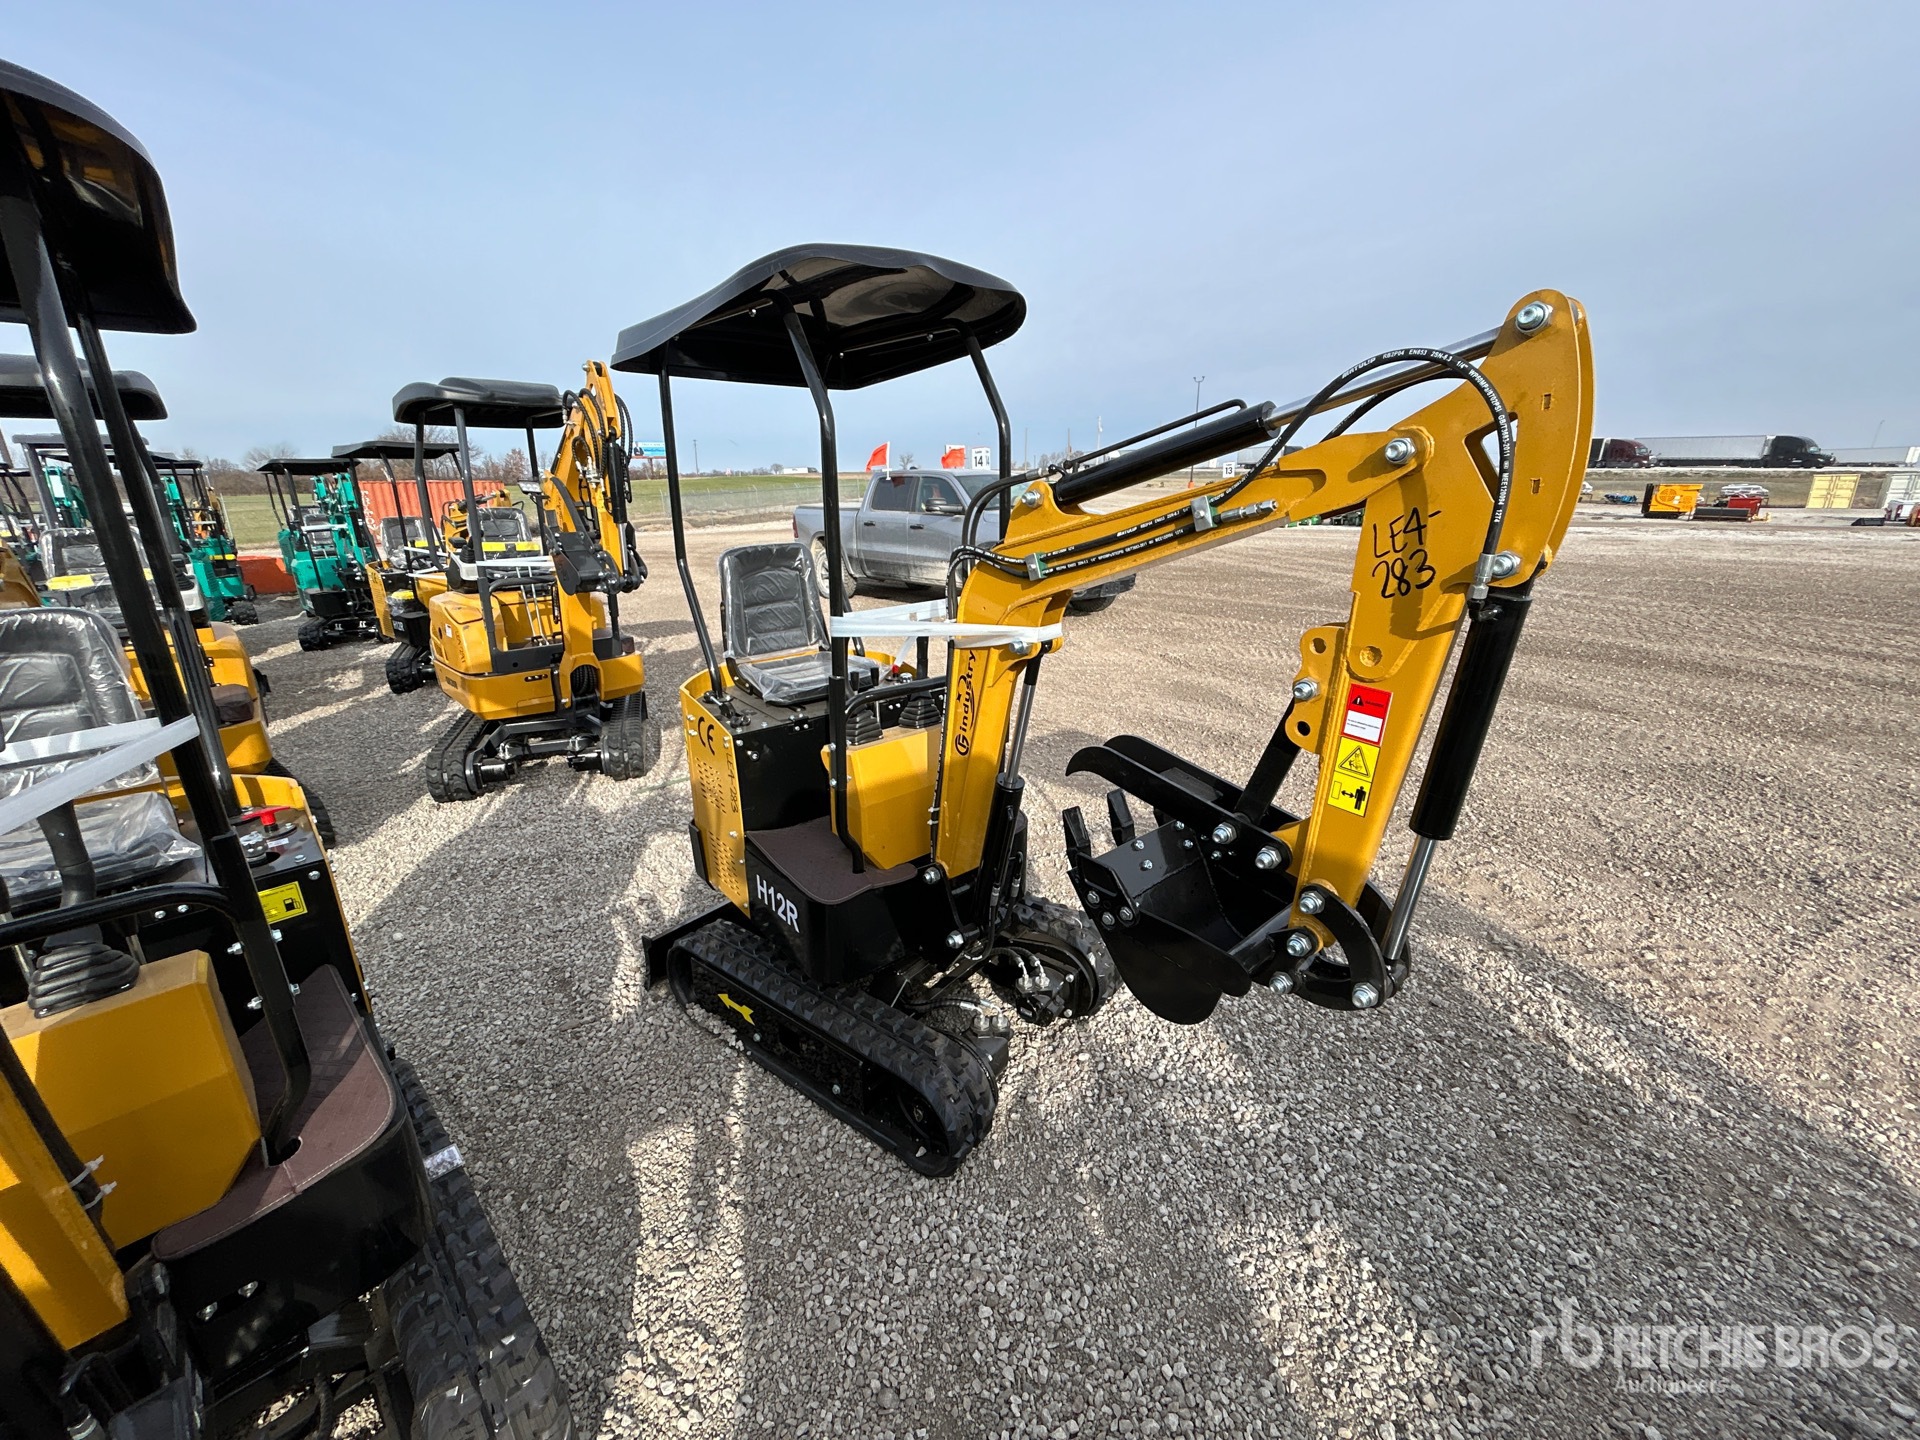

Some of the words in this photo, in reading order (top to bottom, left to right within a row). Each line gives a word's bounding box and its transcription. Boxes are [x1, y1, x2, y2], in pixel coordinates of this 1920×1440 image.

[974, 456, 983, 467] 14
[1225, 467, 1233, 475] 13
[1373, 507, 1442, 558] LE4-
[1372, 548, 1436, 598] 283
[698, 716, 715, 756] CE
[756, 874, 800, 933] H12R
